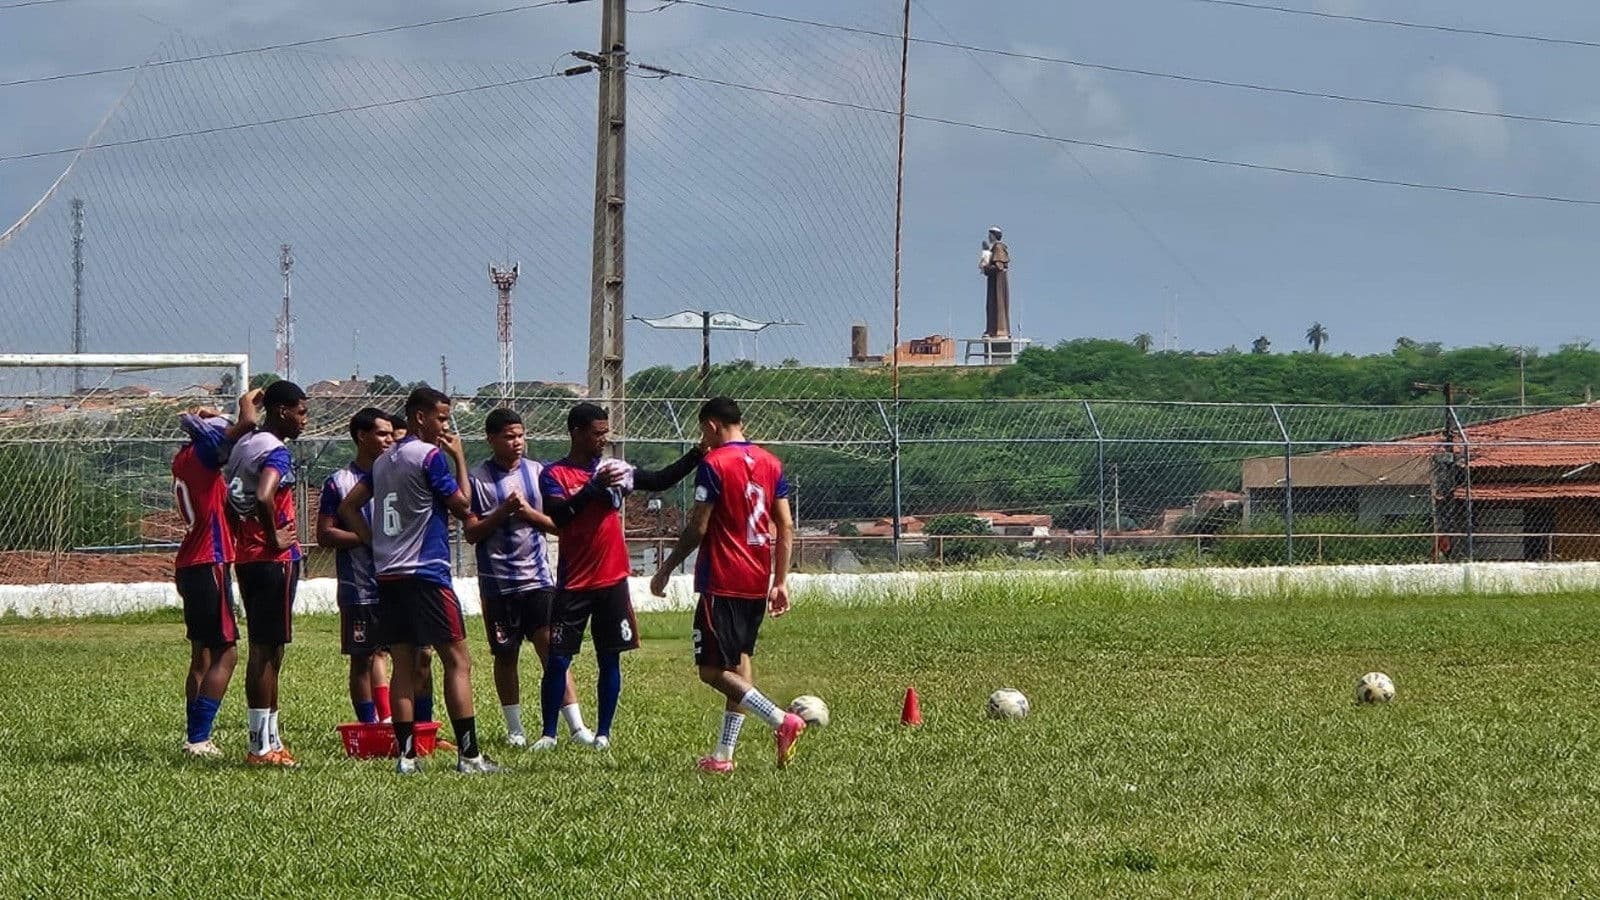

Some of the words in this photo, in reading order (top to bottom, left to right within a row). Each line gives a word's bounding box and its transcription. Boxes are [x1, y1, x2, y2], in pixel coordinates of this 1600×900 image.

[383, 491, 402, 536] 6
[745, 481, 770, 546] 2
[620, 618, 632, 641] 8
